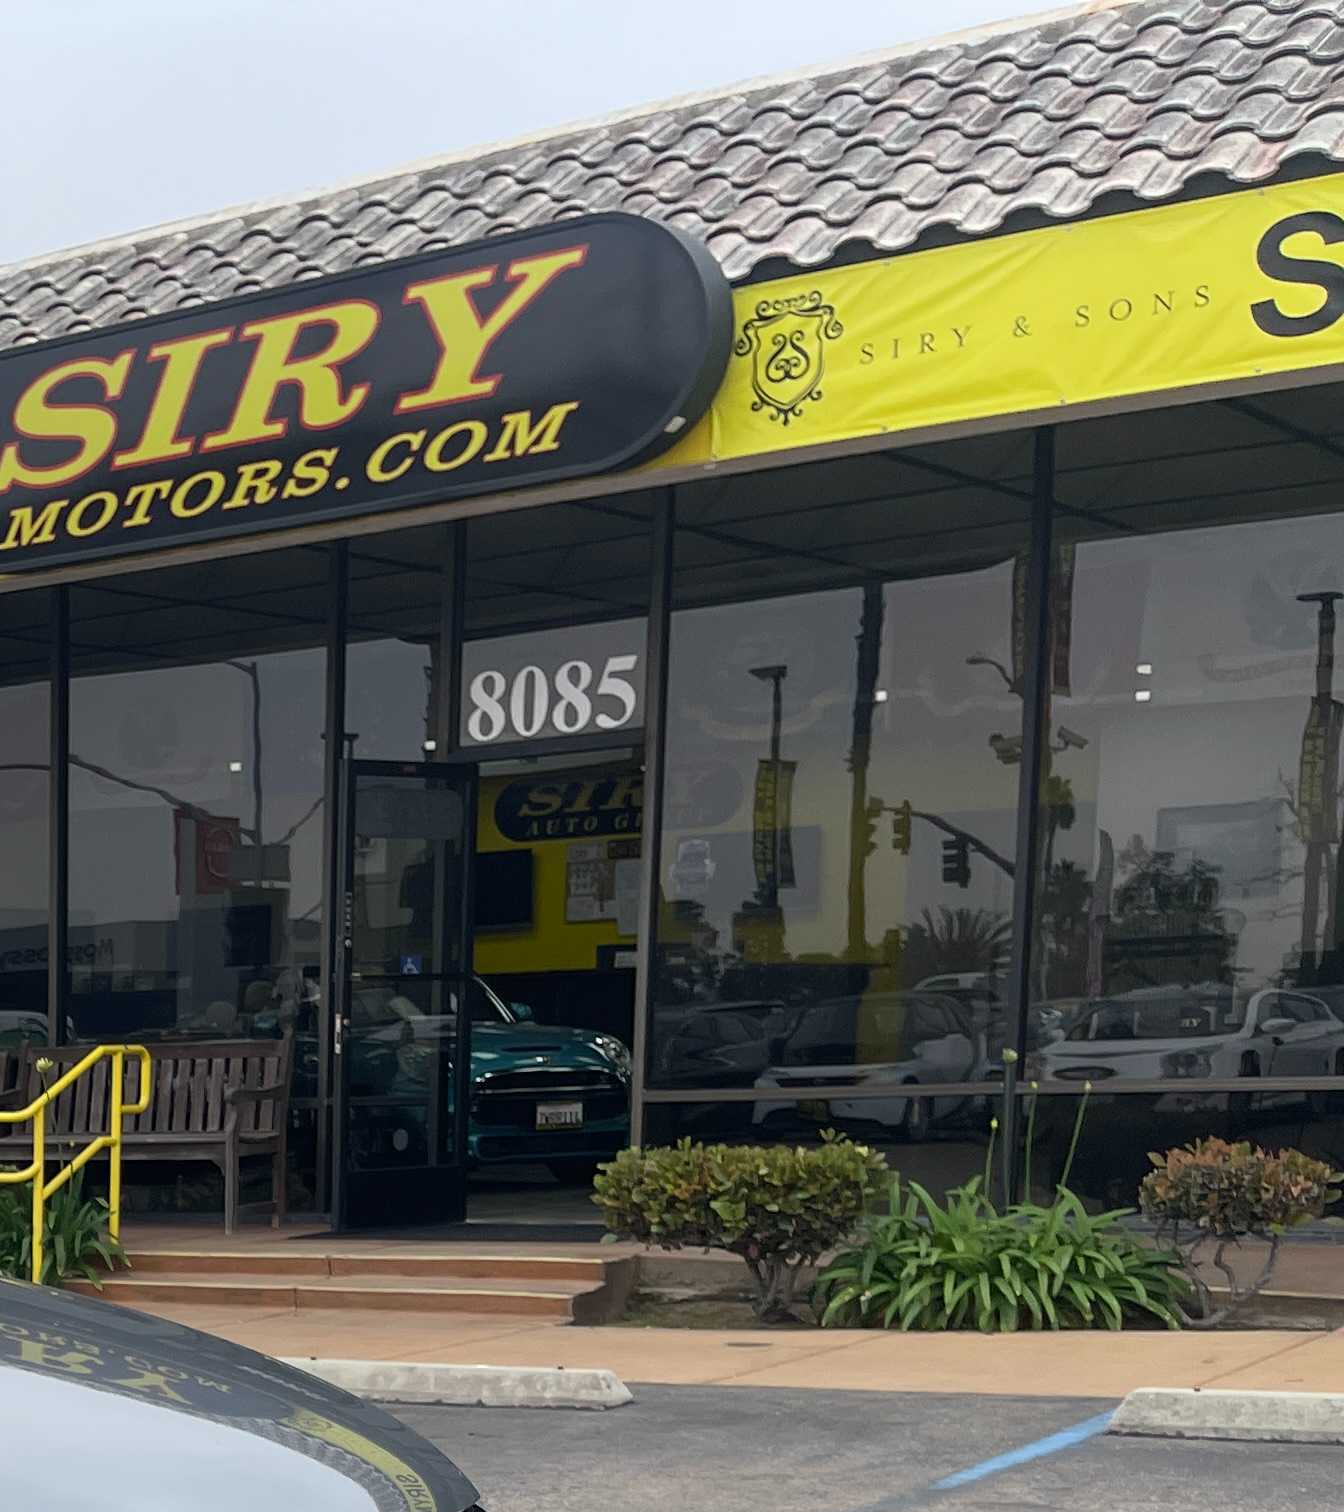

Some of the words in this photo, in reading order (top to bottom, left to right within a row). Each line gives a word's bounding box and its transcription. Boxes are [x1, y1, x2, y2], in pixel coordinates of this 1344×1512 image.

[859, 325, 973, 366] SIRY
[1011, 317, 1032, 338] &
[1074, 284, 1212, 328] SONS
[468, 655, 639, 744] 8085
